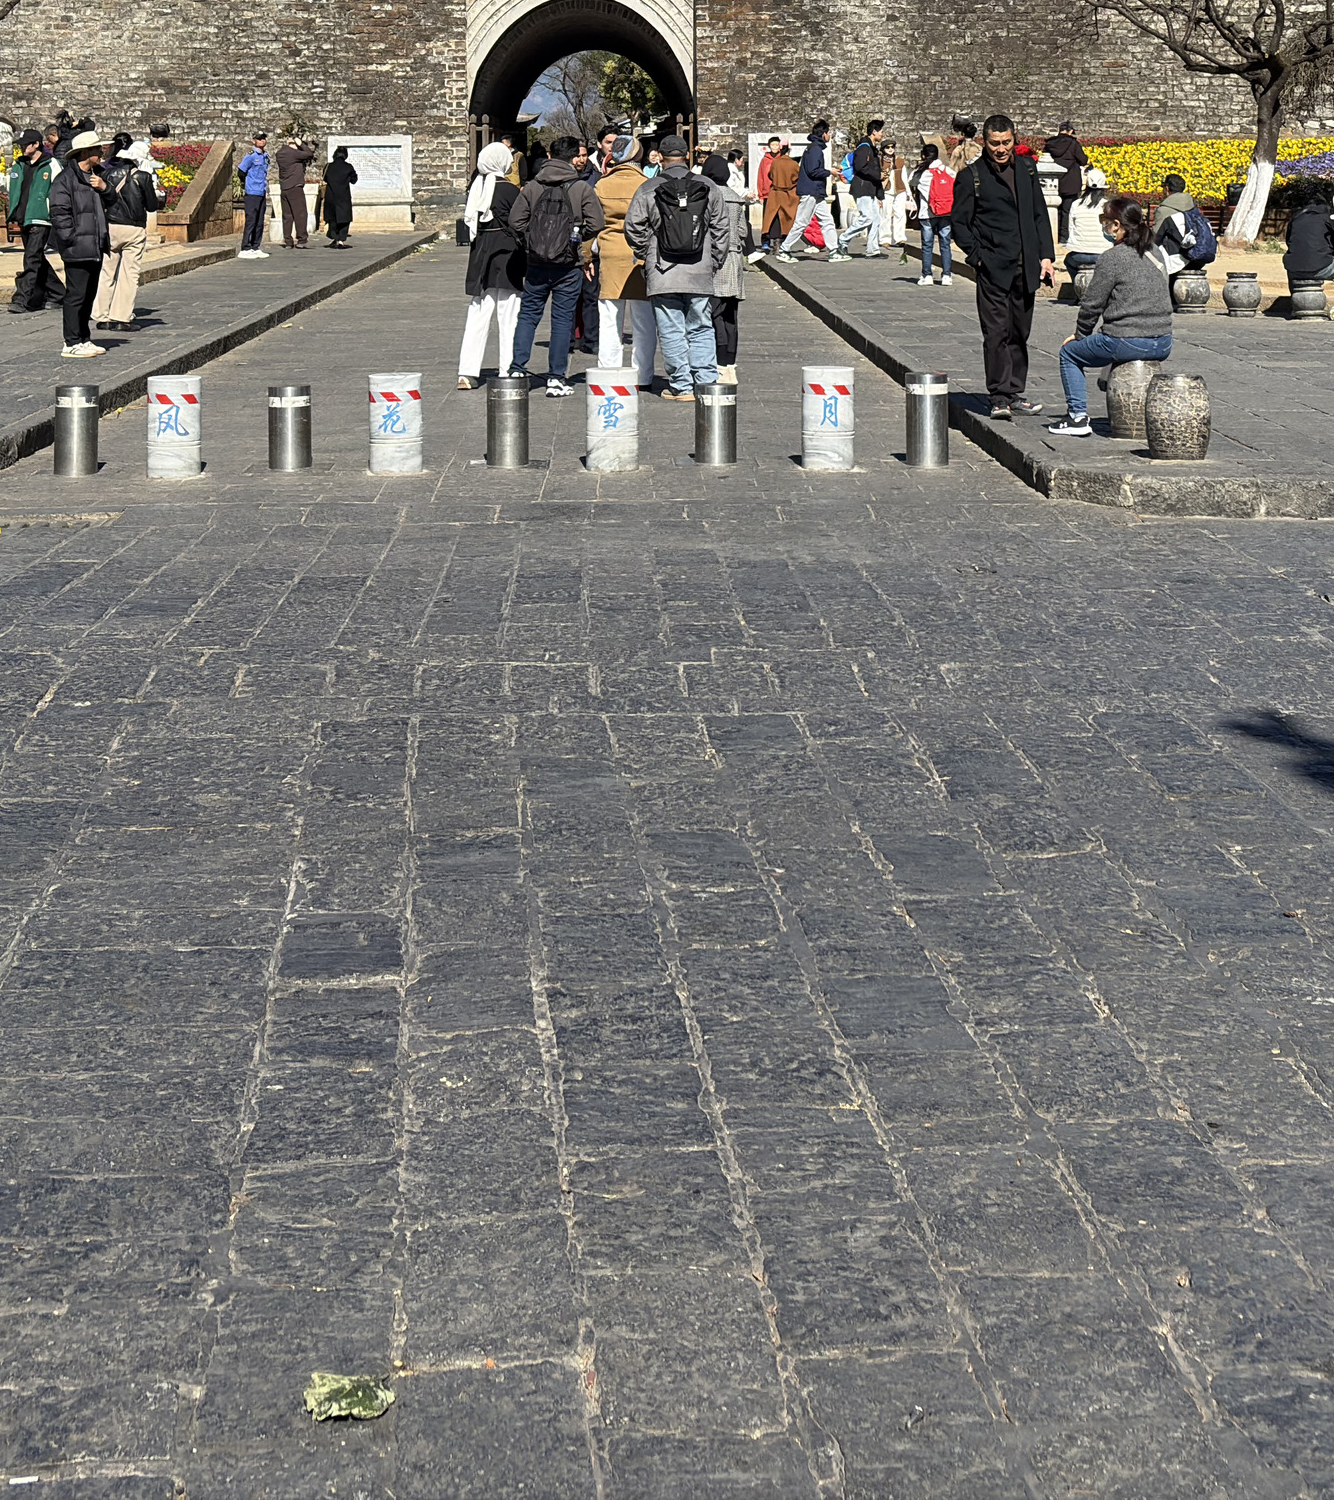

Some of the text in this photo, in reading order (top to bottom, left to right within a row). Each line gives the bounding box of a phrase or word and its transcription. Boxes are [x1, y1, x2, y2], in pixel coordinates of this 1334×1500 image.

[378, 402, 407, 434] 花
[597, 396, 624, 429] 雪
[820, 395, 839, 427] 月
